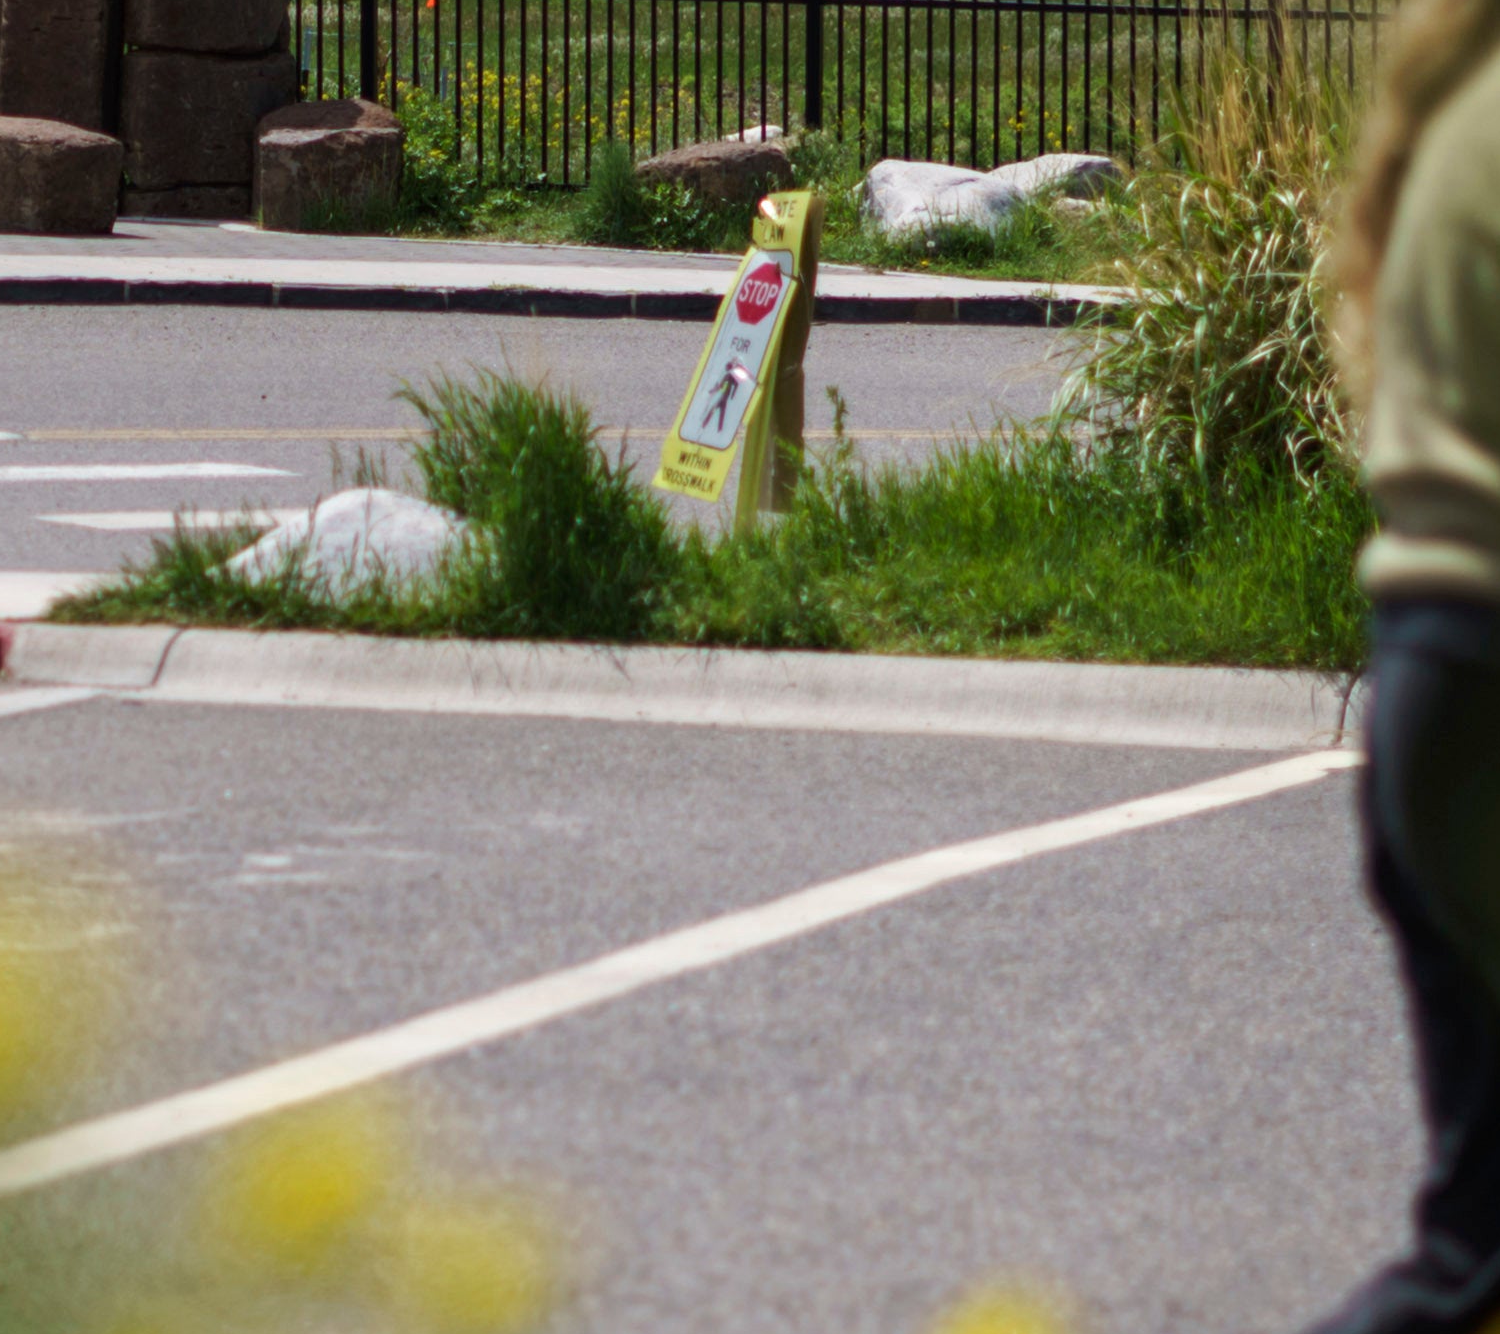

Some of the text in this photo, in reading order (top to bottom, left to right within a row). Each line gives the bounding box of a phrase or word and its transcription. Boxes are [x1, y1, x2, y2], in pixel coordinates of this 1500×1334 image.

[762, 223, 786, 243] LAW
[738, 279, 779, 307] STOP
[730, 336, 752, 353] FOR
[678, 451, 713, 471] WITHIN
